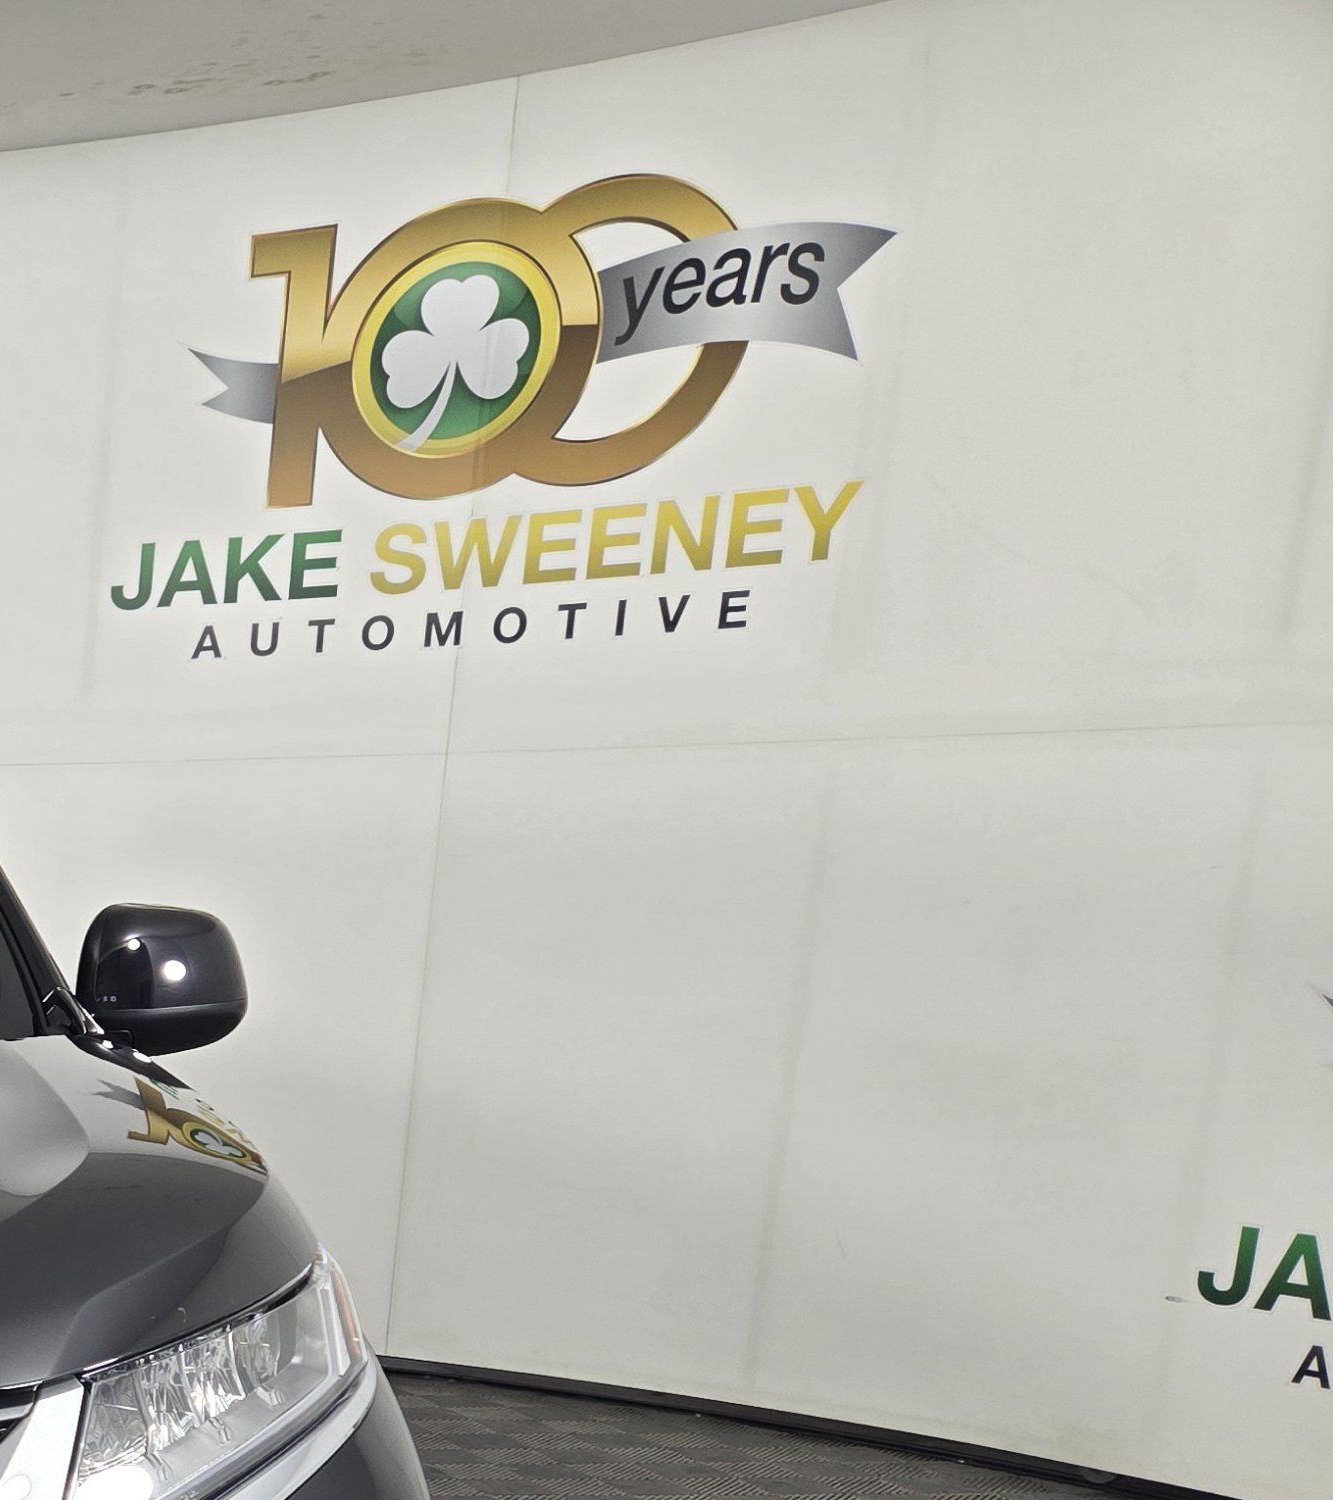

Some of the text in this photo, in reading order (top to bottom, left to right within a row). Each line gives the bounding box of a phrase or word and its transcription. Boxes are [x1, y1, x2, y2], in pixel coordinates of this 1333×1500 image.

[614, 242, 825, 346] years
[110, 480, 864, 611] JAKE SWEENEY
[191, 590, 751, 660] AUTOMOTIVE
[1197, 1225, 1333, 1321] JA
